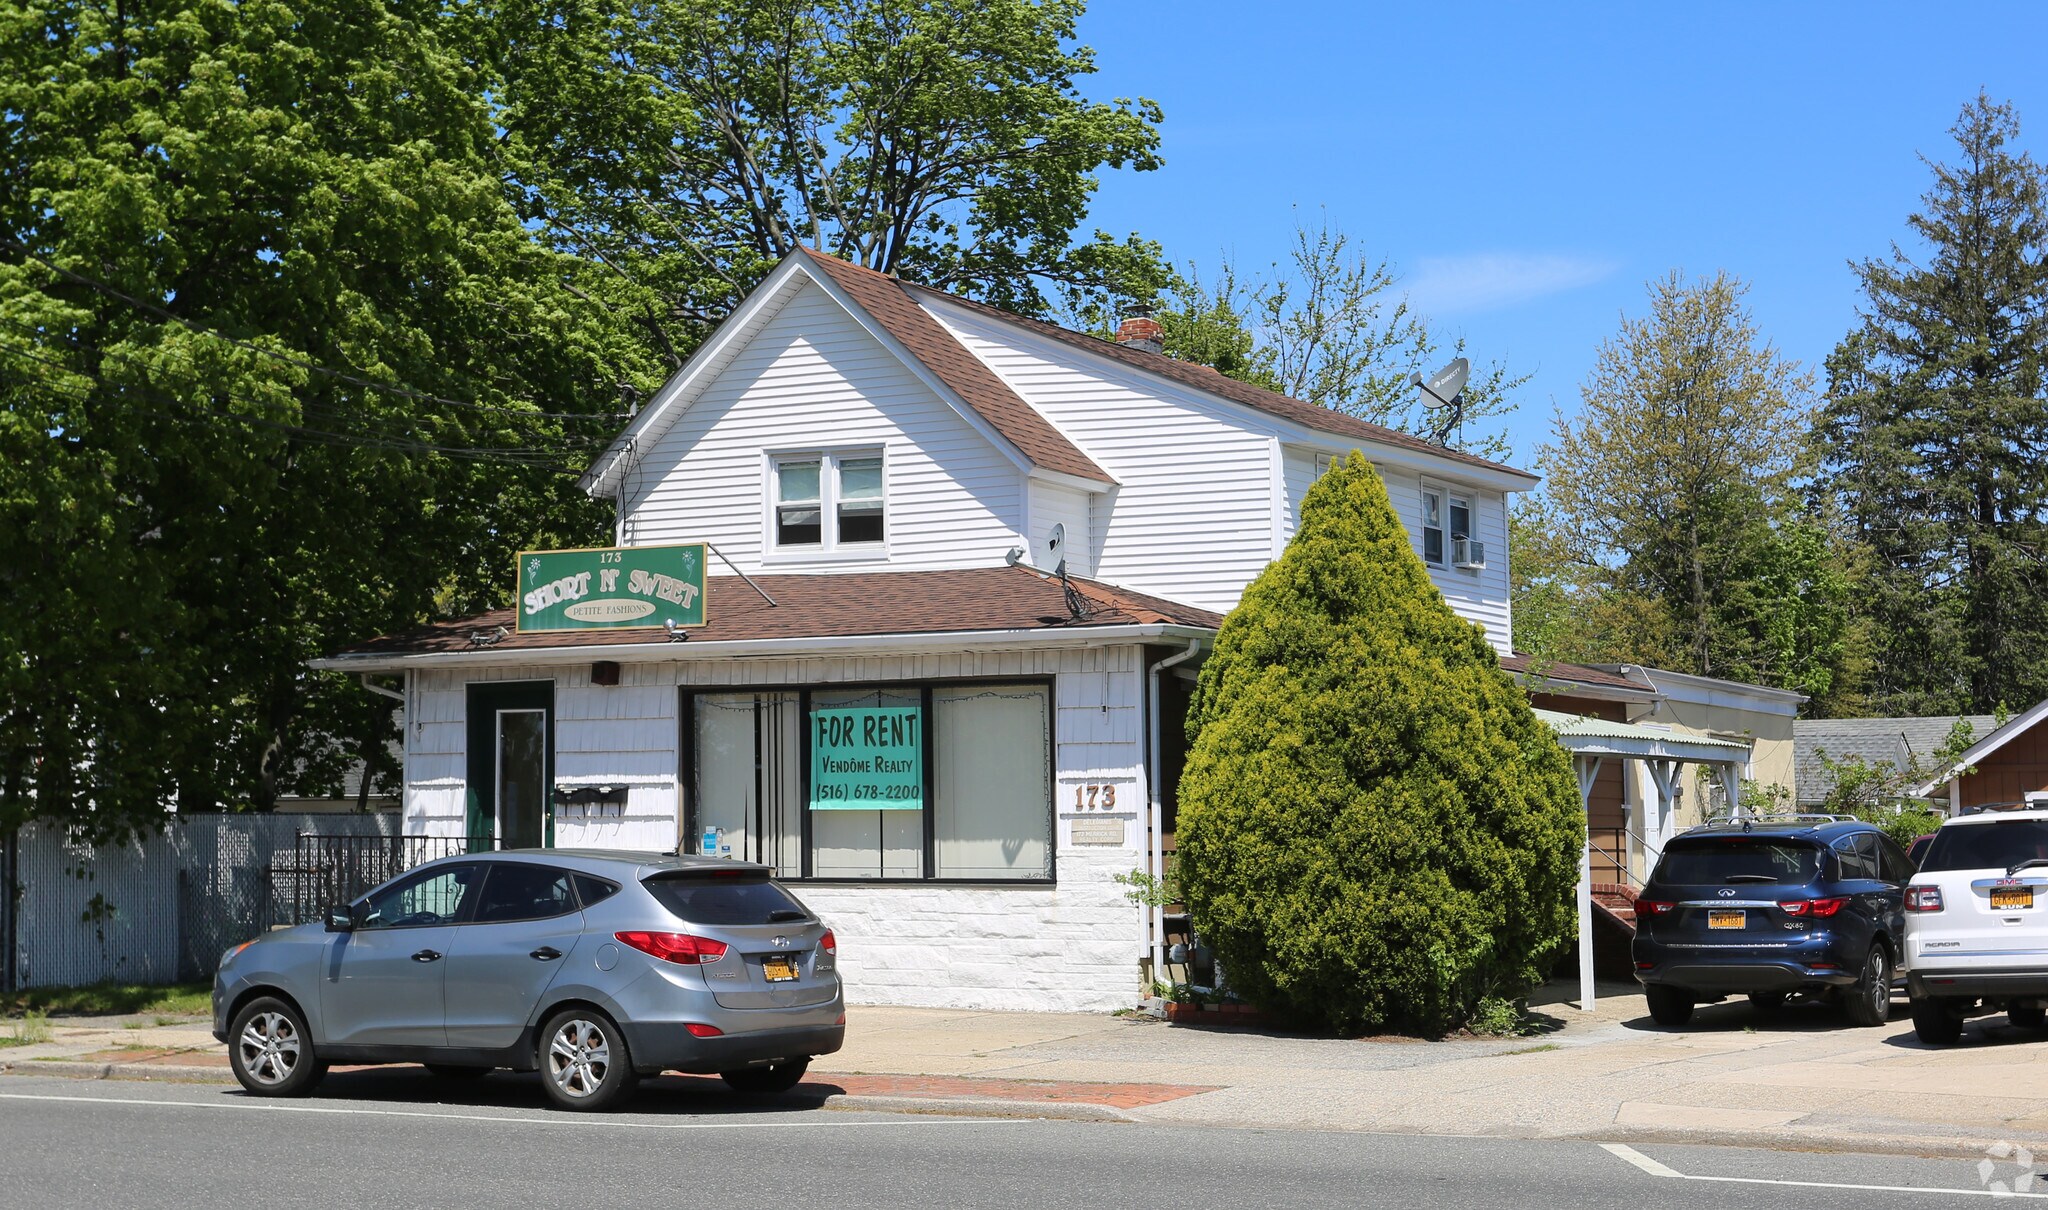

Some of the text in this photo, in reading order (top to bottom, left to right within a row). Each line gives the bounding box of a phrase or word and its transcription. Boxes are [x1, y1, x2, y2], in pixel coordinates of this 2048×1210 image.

[600, 552, 622, 564] 173
[524, 571, 592, 615] SHORT
[628, 569, 699, 609] SWEET
[573, 605, 647, 616] PETITE FASHIONS
[817, 714, 917, 748] FOR RENT
[816, 783, 920, 802] (516) 678-2200
[1075, 784, 1116, 808] 173
